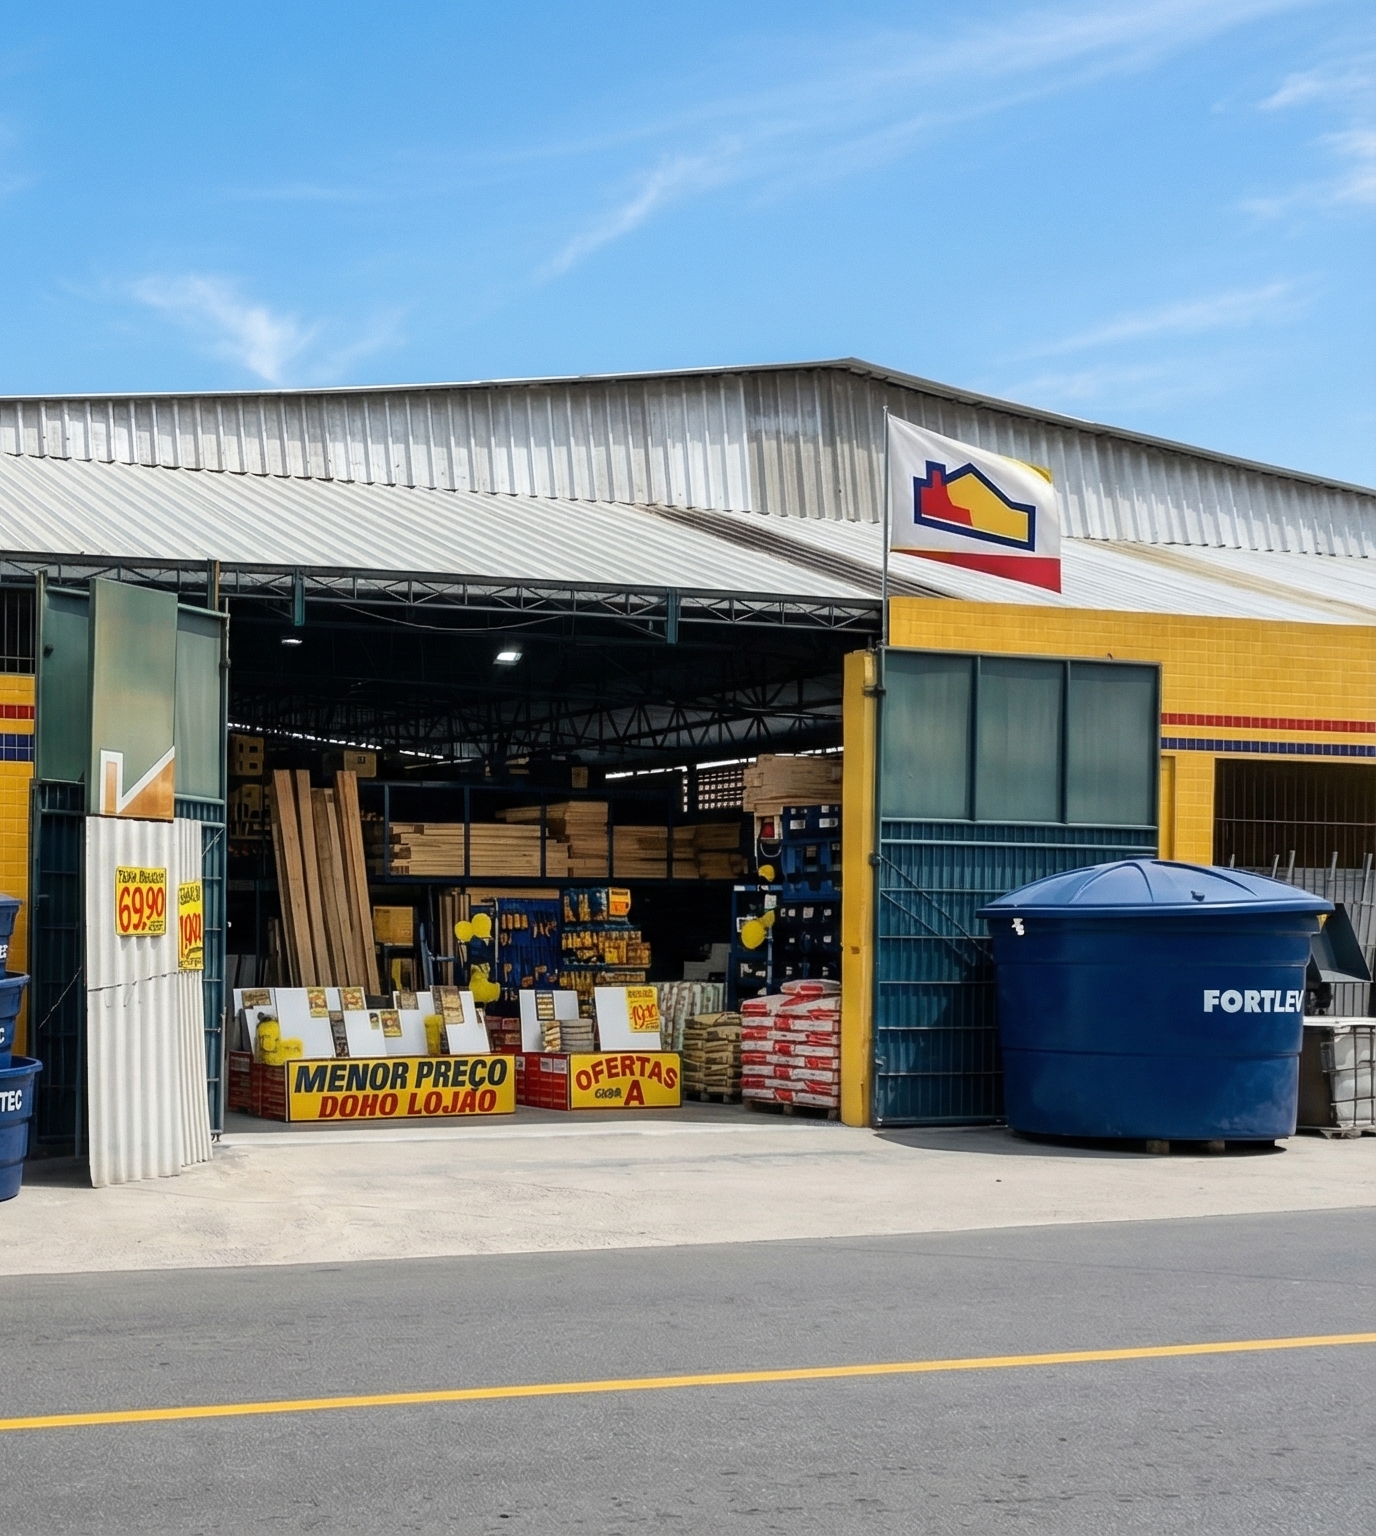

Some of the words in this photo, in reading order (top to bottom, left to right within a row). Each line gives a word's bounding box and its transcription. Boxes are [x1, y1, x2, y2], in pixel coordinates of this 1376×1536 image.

[1203, 989, 1304, 1013] FORTLEV
[294, 1061, 409, 1094] MENOR
[575, 1055, 678, 1091] OFERTAS
[624, 1079, 645, 1106] A
[318, 1094, 398, 1119] DOHO
